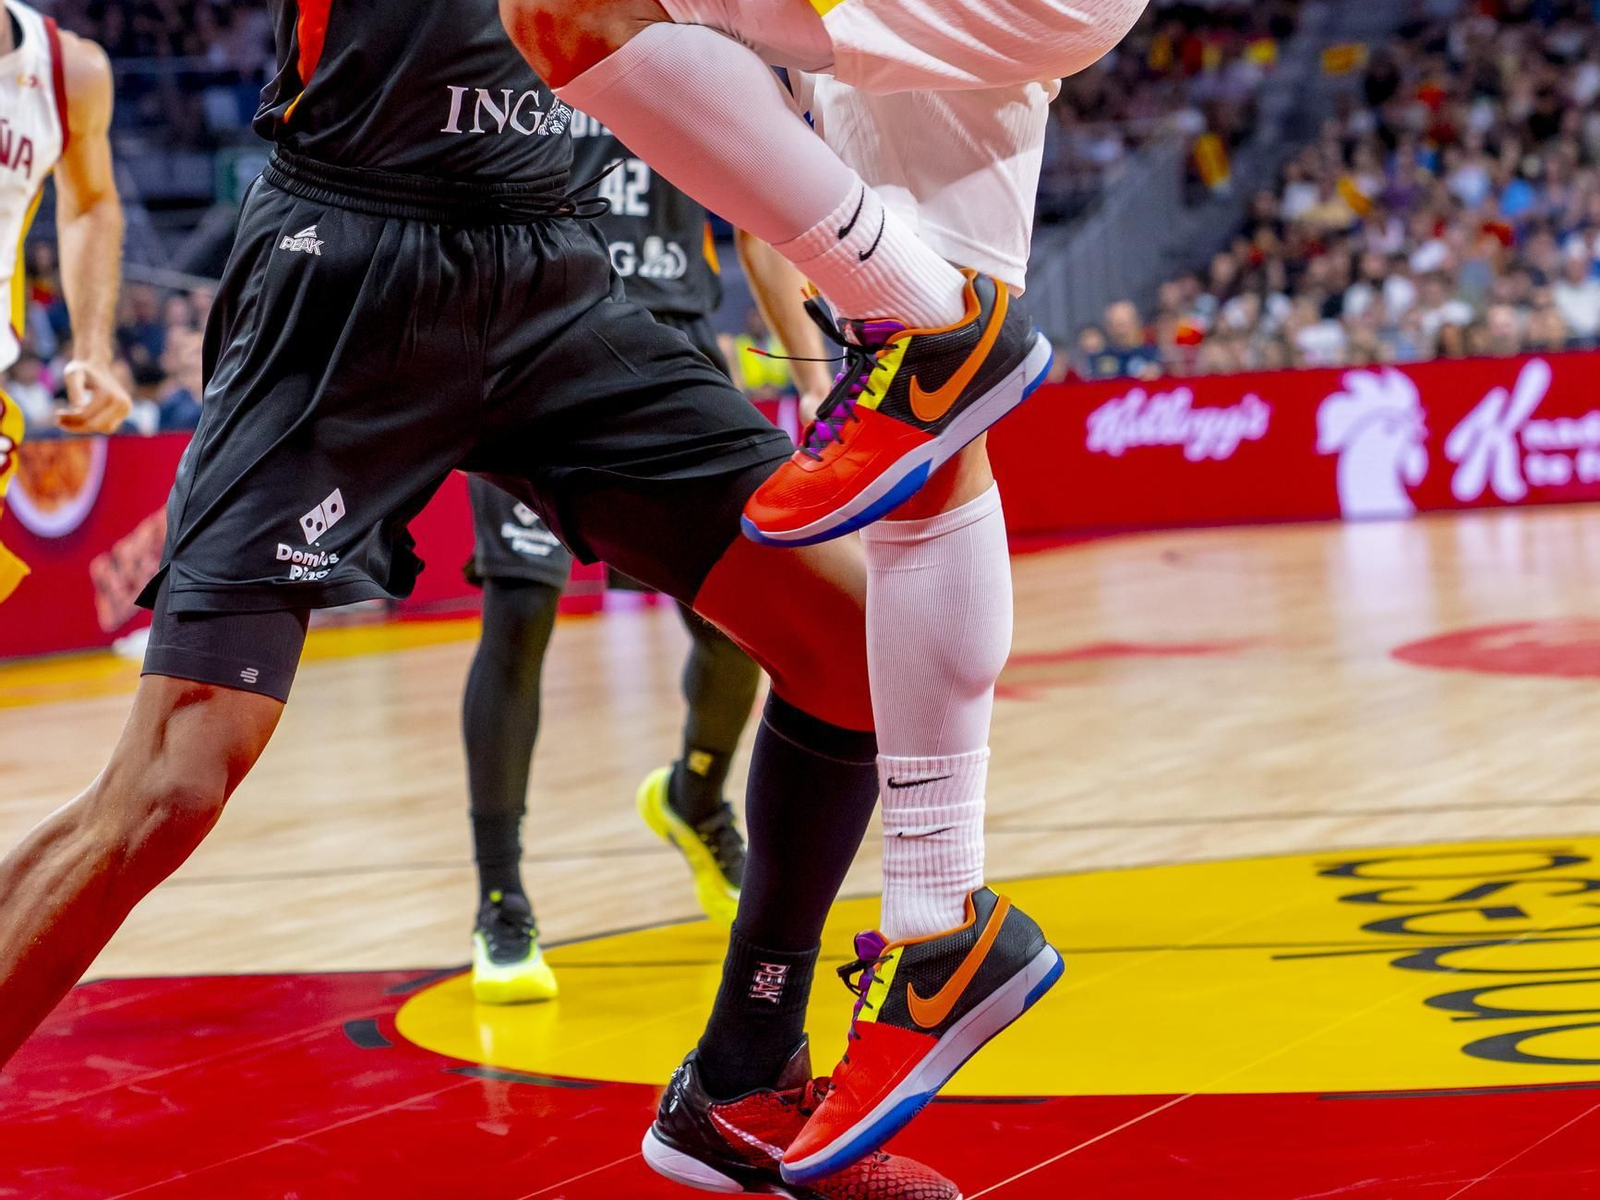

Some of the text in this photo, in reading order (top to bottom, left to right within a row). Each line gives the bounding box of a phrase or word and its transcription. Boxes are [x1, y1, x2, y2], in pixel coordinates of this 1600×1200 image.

[440, 85, 545, 136] ING
[598, 157, 651, 217] 42
[279, 235, 325, 256] PEAK
[750, 961, 788, 1003] PEAK
